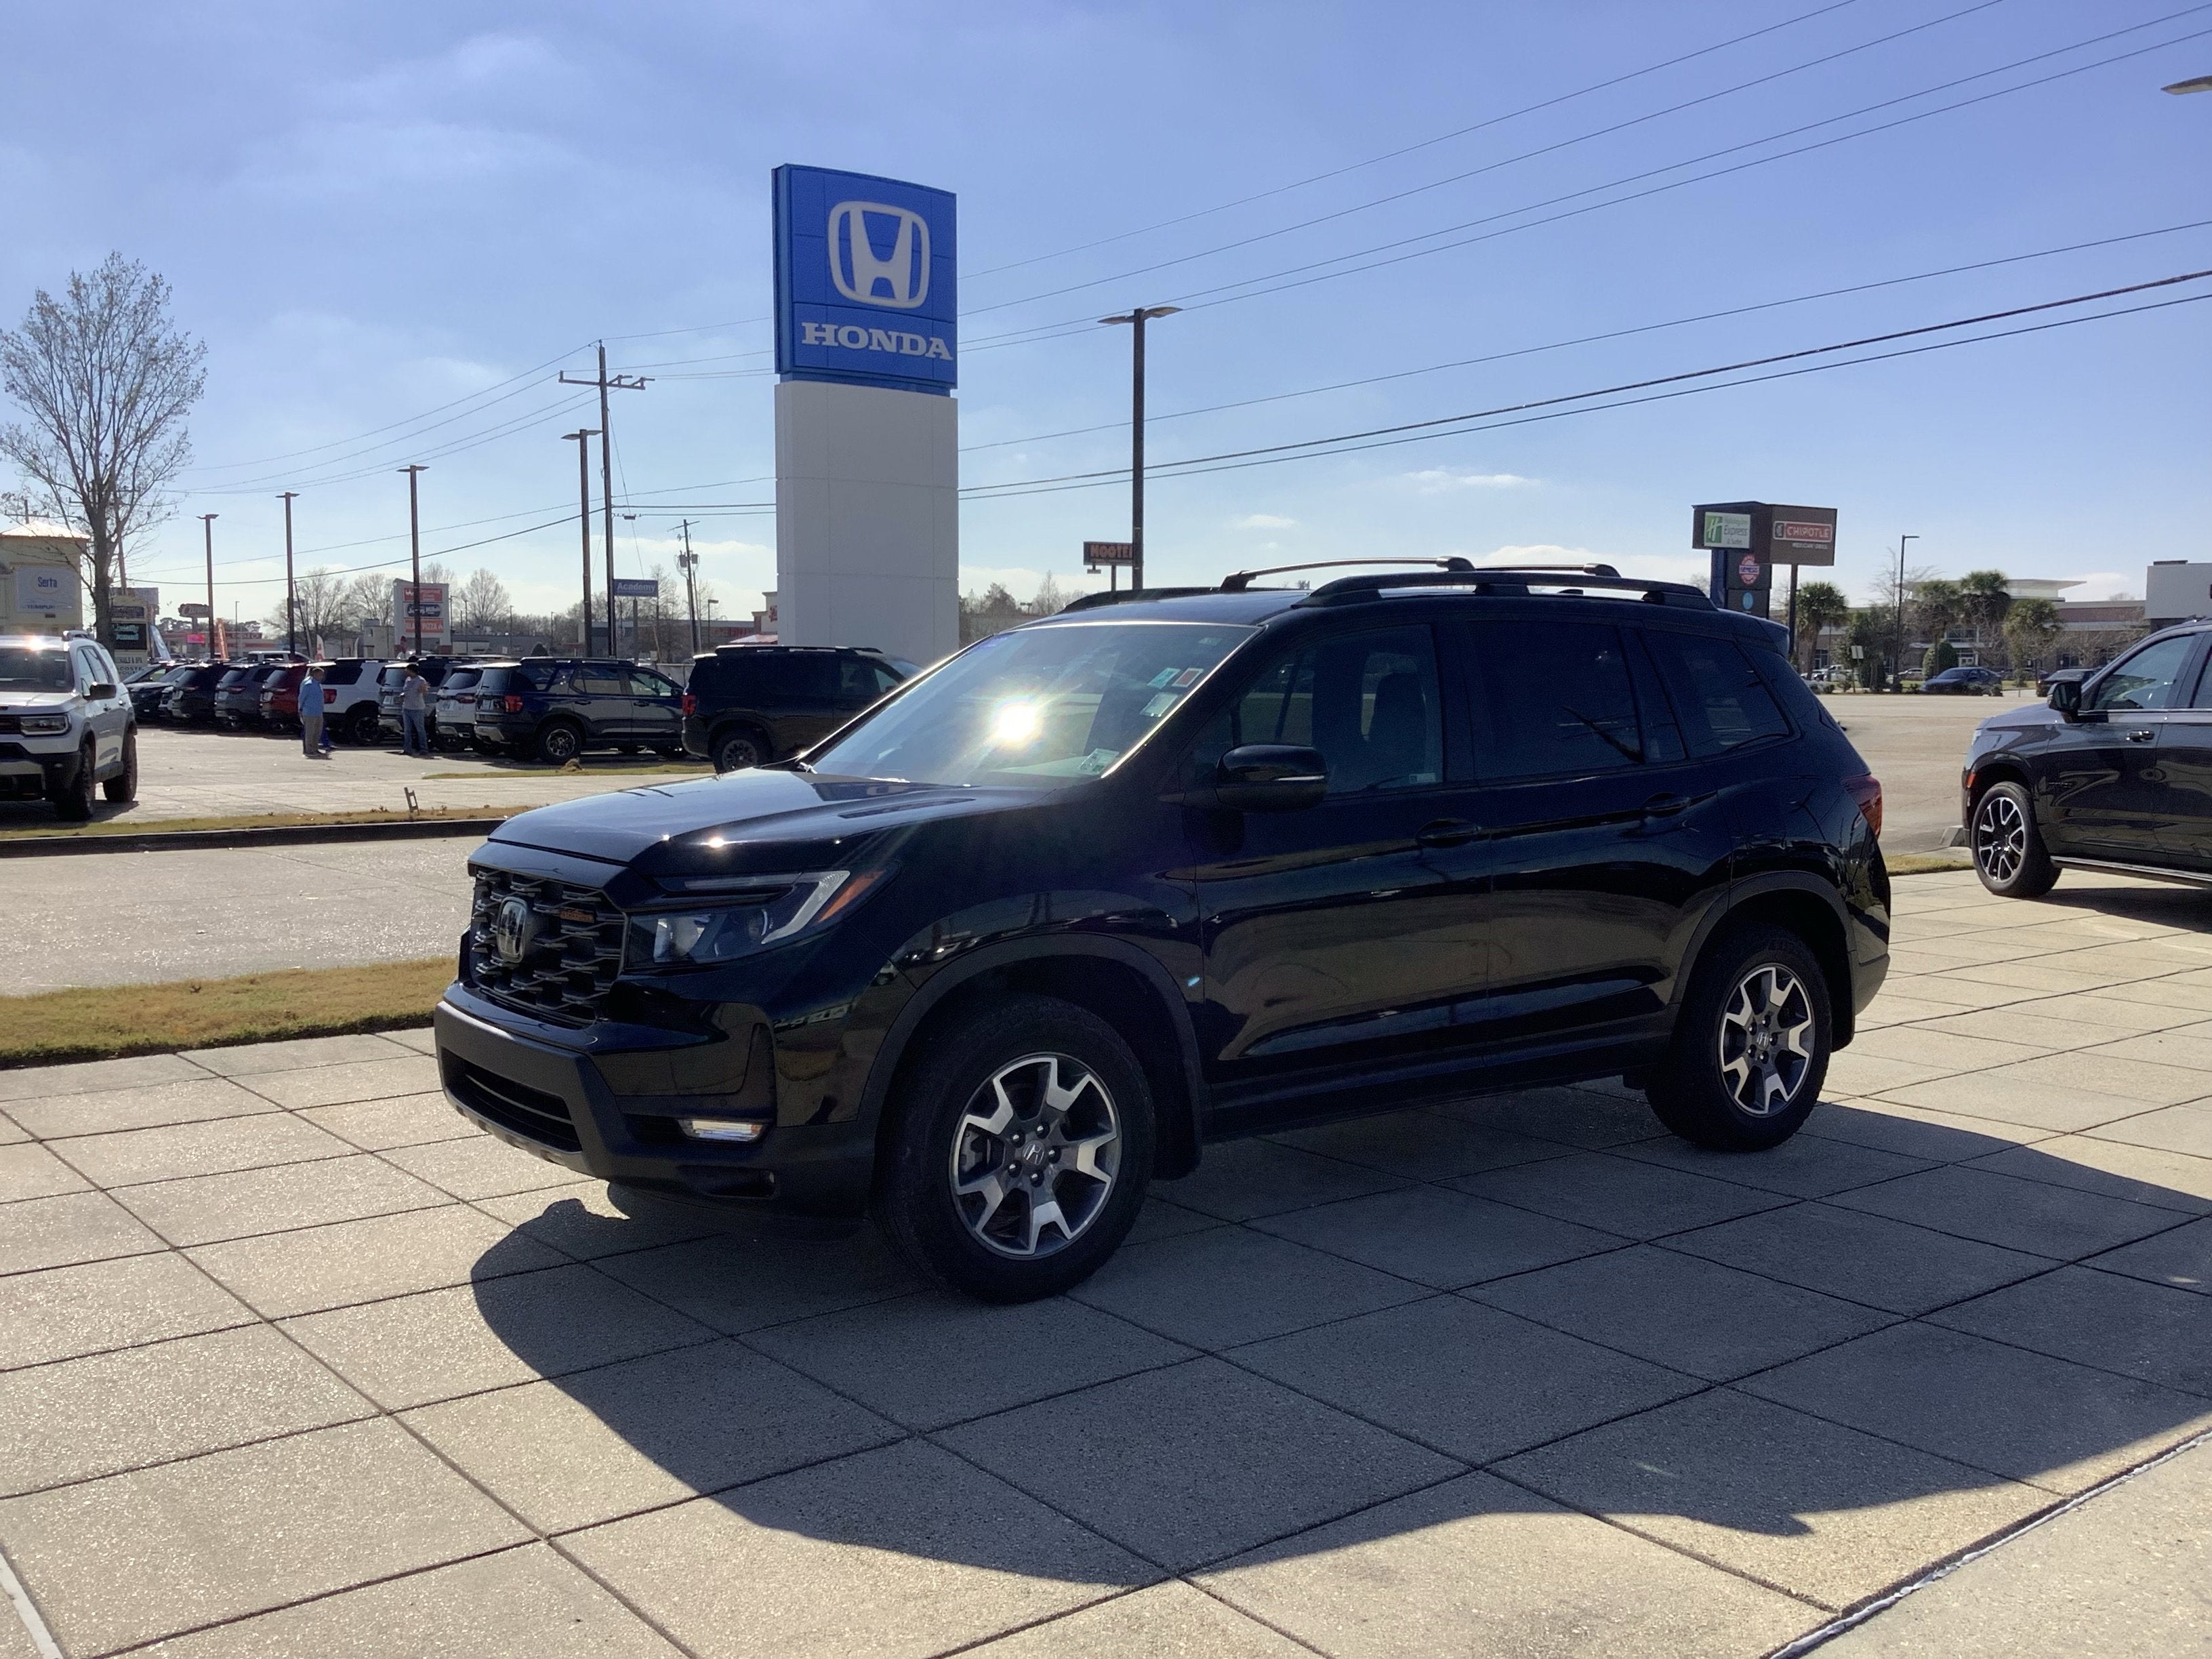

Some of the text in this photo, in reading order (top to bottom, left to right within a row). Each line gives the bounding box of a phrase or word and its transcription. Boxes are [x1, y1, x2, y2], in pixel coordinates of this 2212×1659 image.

[802, 322, 954, 361] HONDA
[1786, 526, 1828, 538] CHIPOTLE
[37, 576, 58, 588] Serta
[617, 582, 656, 592] Academy
